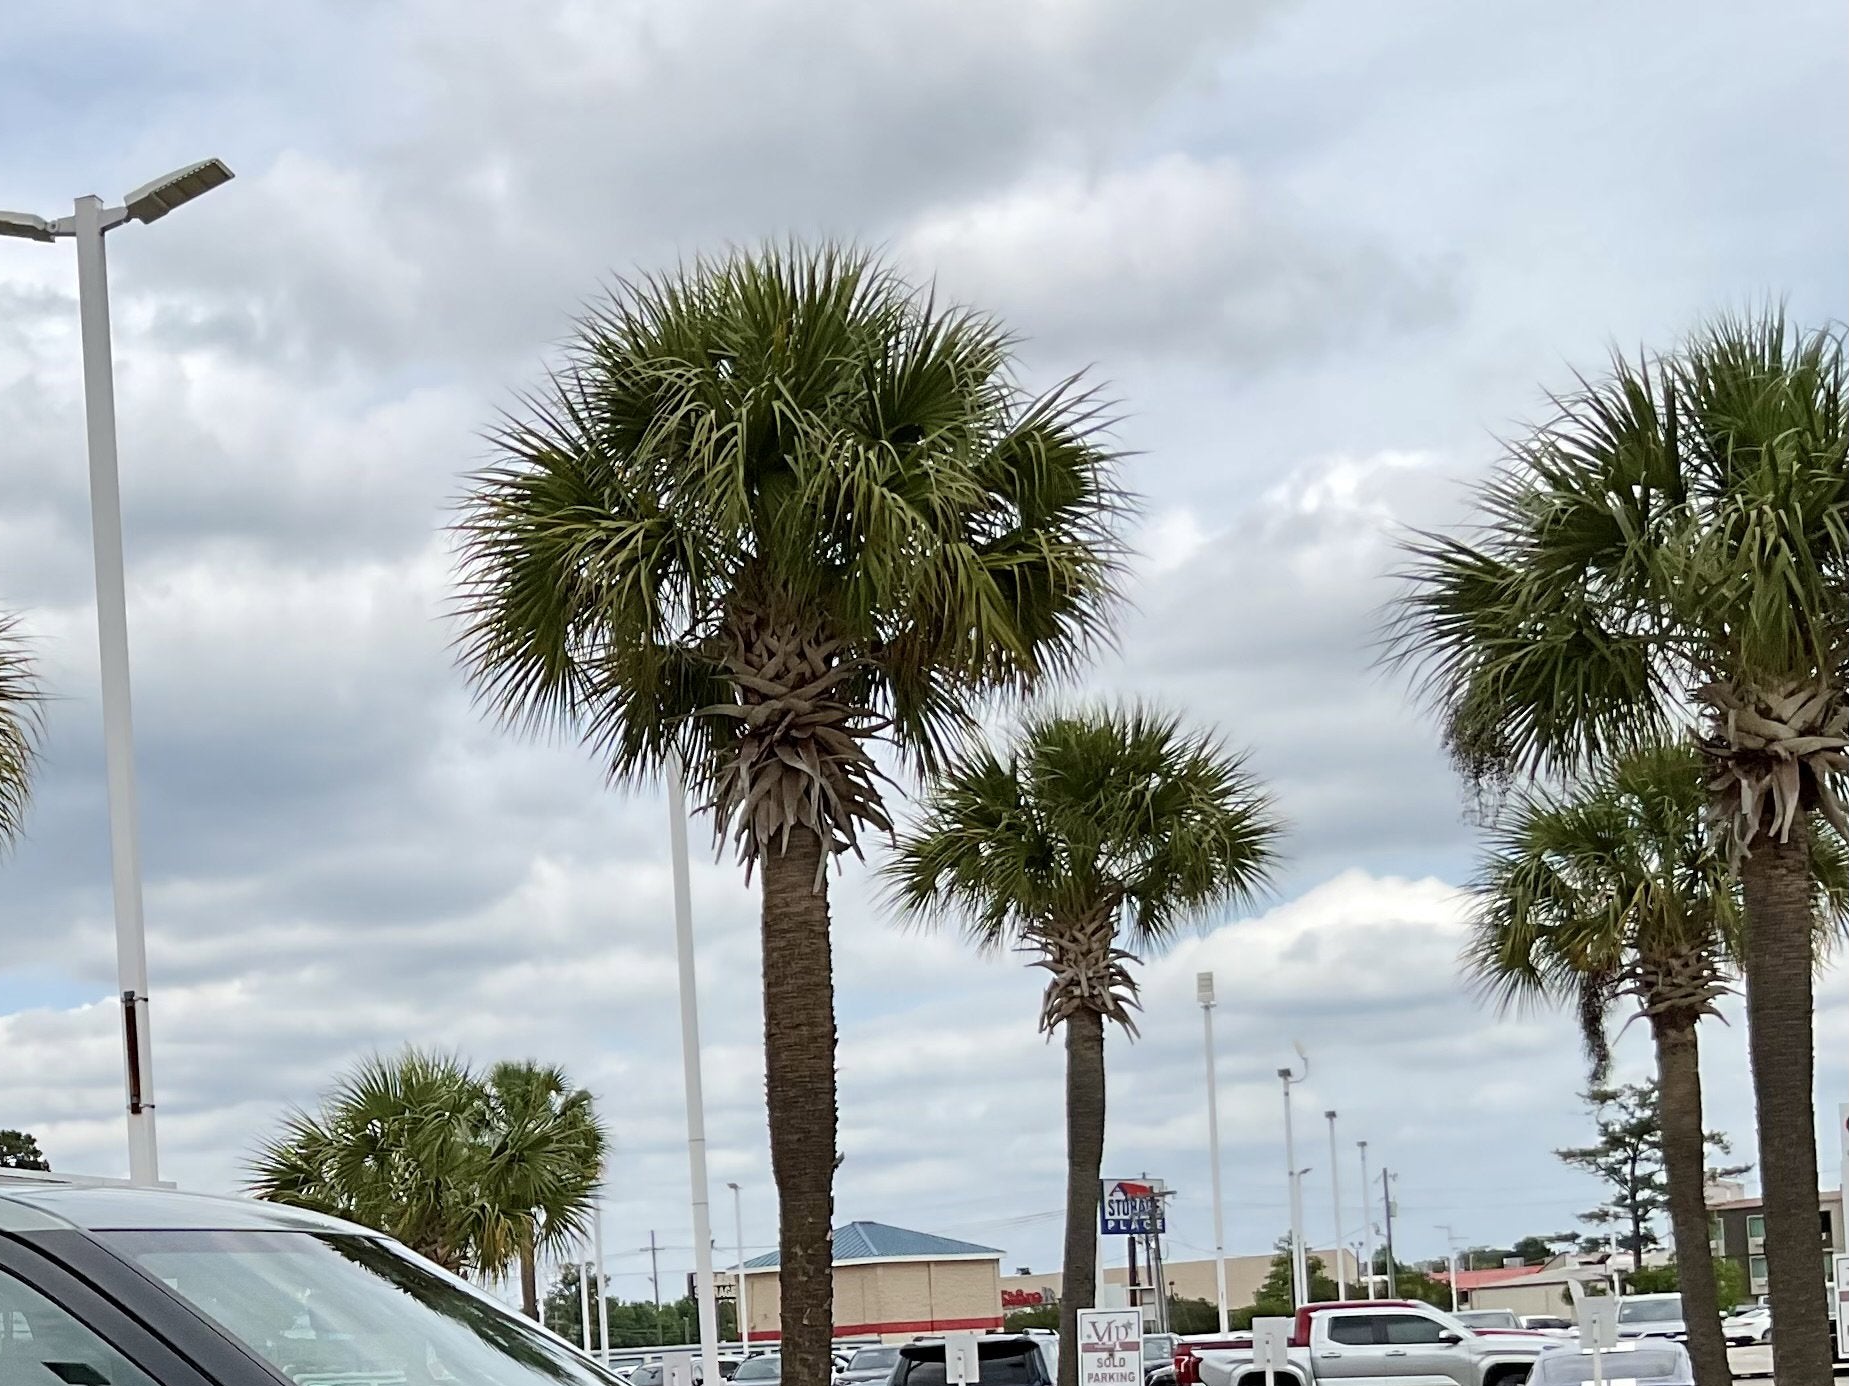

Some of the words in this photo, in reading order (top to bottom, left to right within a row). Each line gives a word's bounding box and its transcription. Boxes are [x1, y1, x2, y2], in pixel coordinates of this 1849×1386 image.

[1107, 1220, 1163, 1230] PLACE
[1097, 1357, 1125, 1368] SOLD
[1087, 1372, 1135, 1383] PARKING
